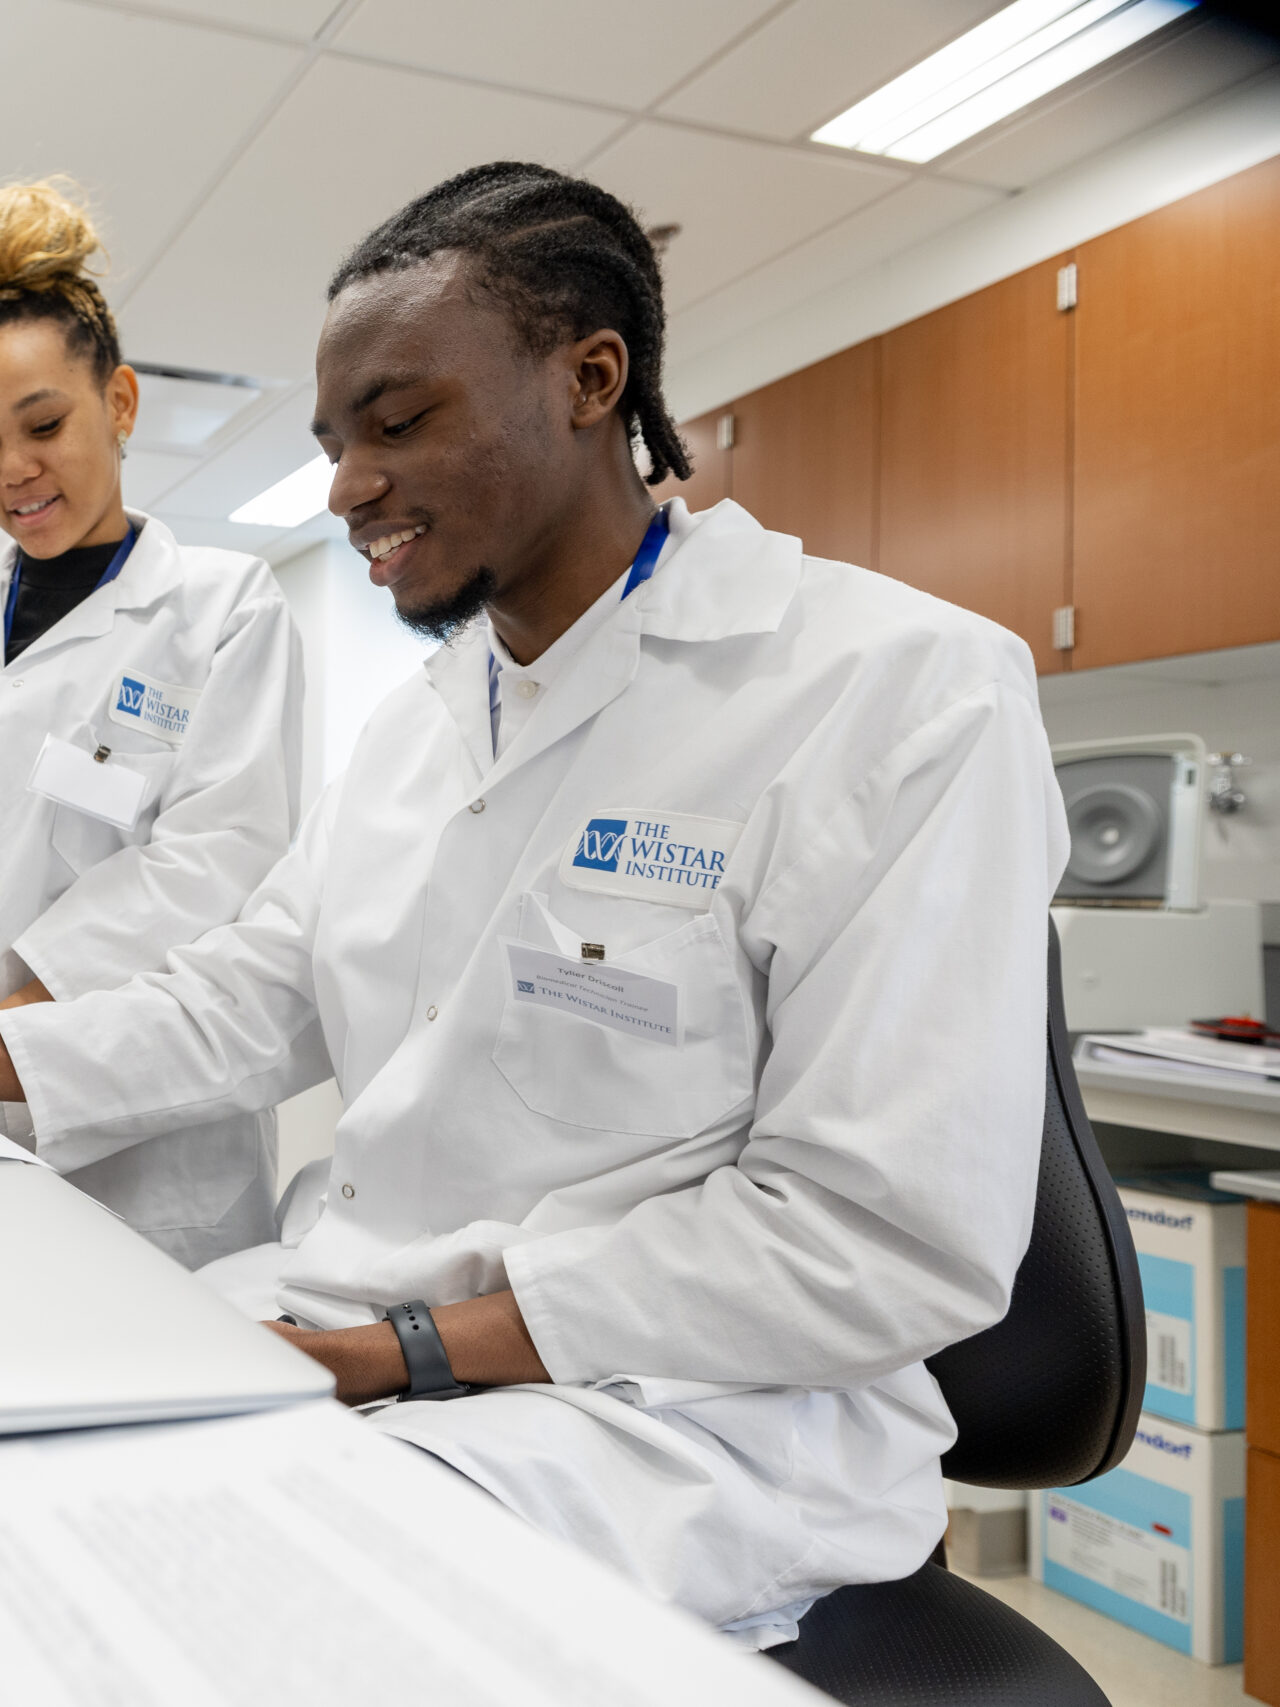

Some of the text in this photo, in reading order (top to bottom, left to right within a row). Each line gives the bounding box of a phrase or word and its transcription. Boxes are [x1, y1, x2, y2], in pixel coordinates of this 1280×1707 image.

[148, 686, 164, 701] THE
[146, 696, 190, 722] WISTAR
[144, 710, 186, 734] INSTITUTE
[634, 820, 670, 840] THE
[631, 837, 725, 872] WISTAR
[539, 986, 672, 1034] THE WISTAR INSTITUTE
